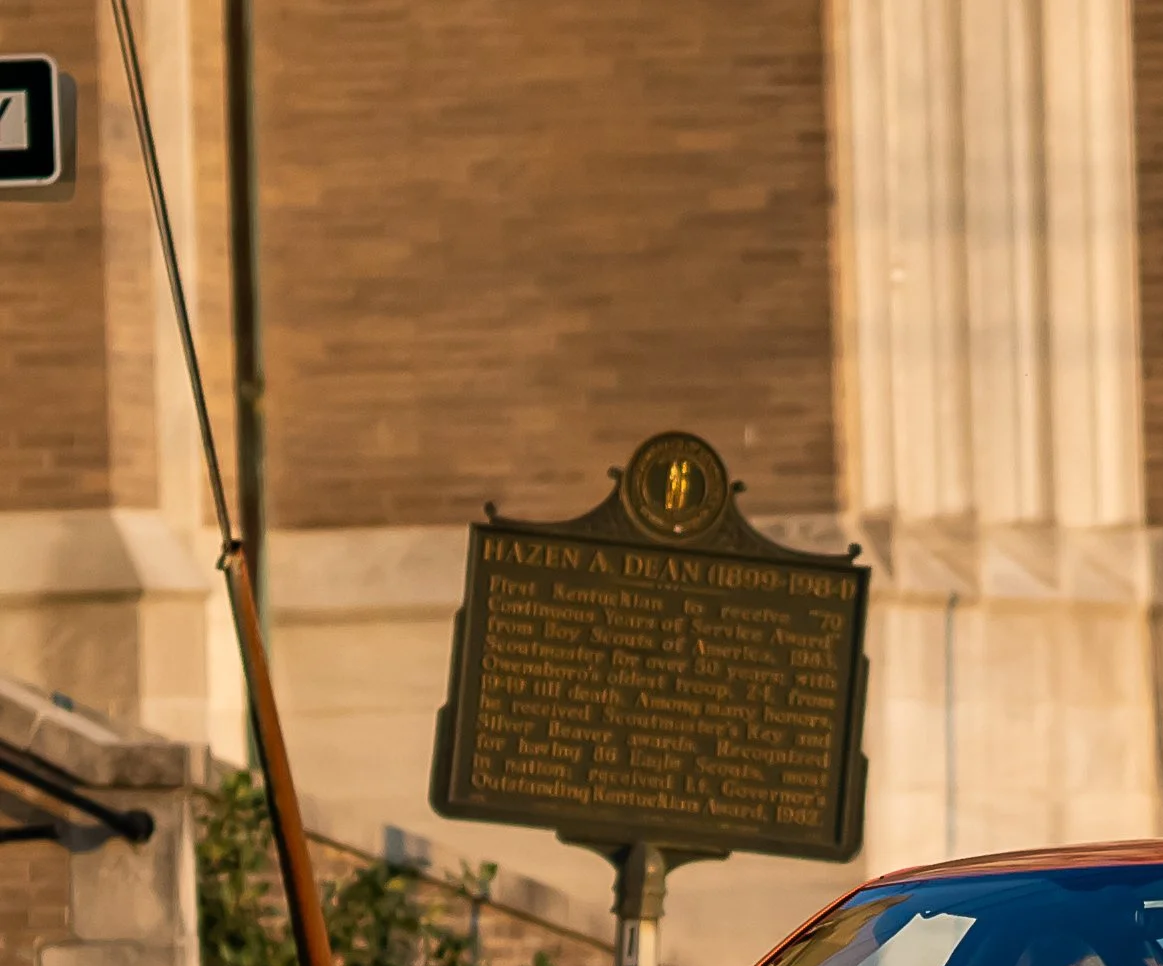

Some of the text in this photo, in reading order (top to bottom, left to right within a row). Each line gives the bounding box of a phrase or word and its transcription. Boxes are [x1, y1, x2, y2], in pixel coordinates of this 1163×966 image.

[483, 536, 583, 571] HAZEN
[623, 552, 702, 584] DEAN
[489, 574, 538, 597] First
